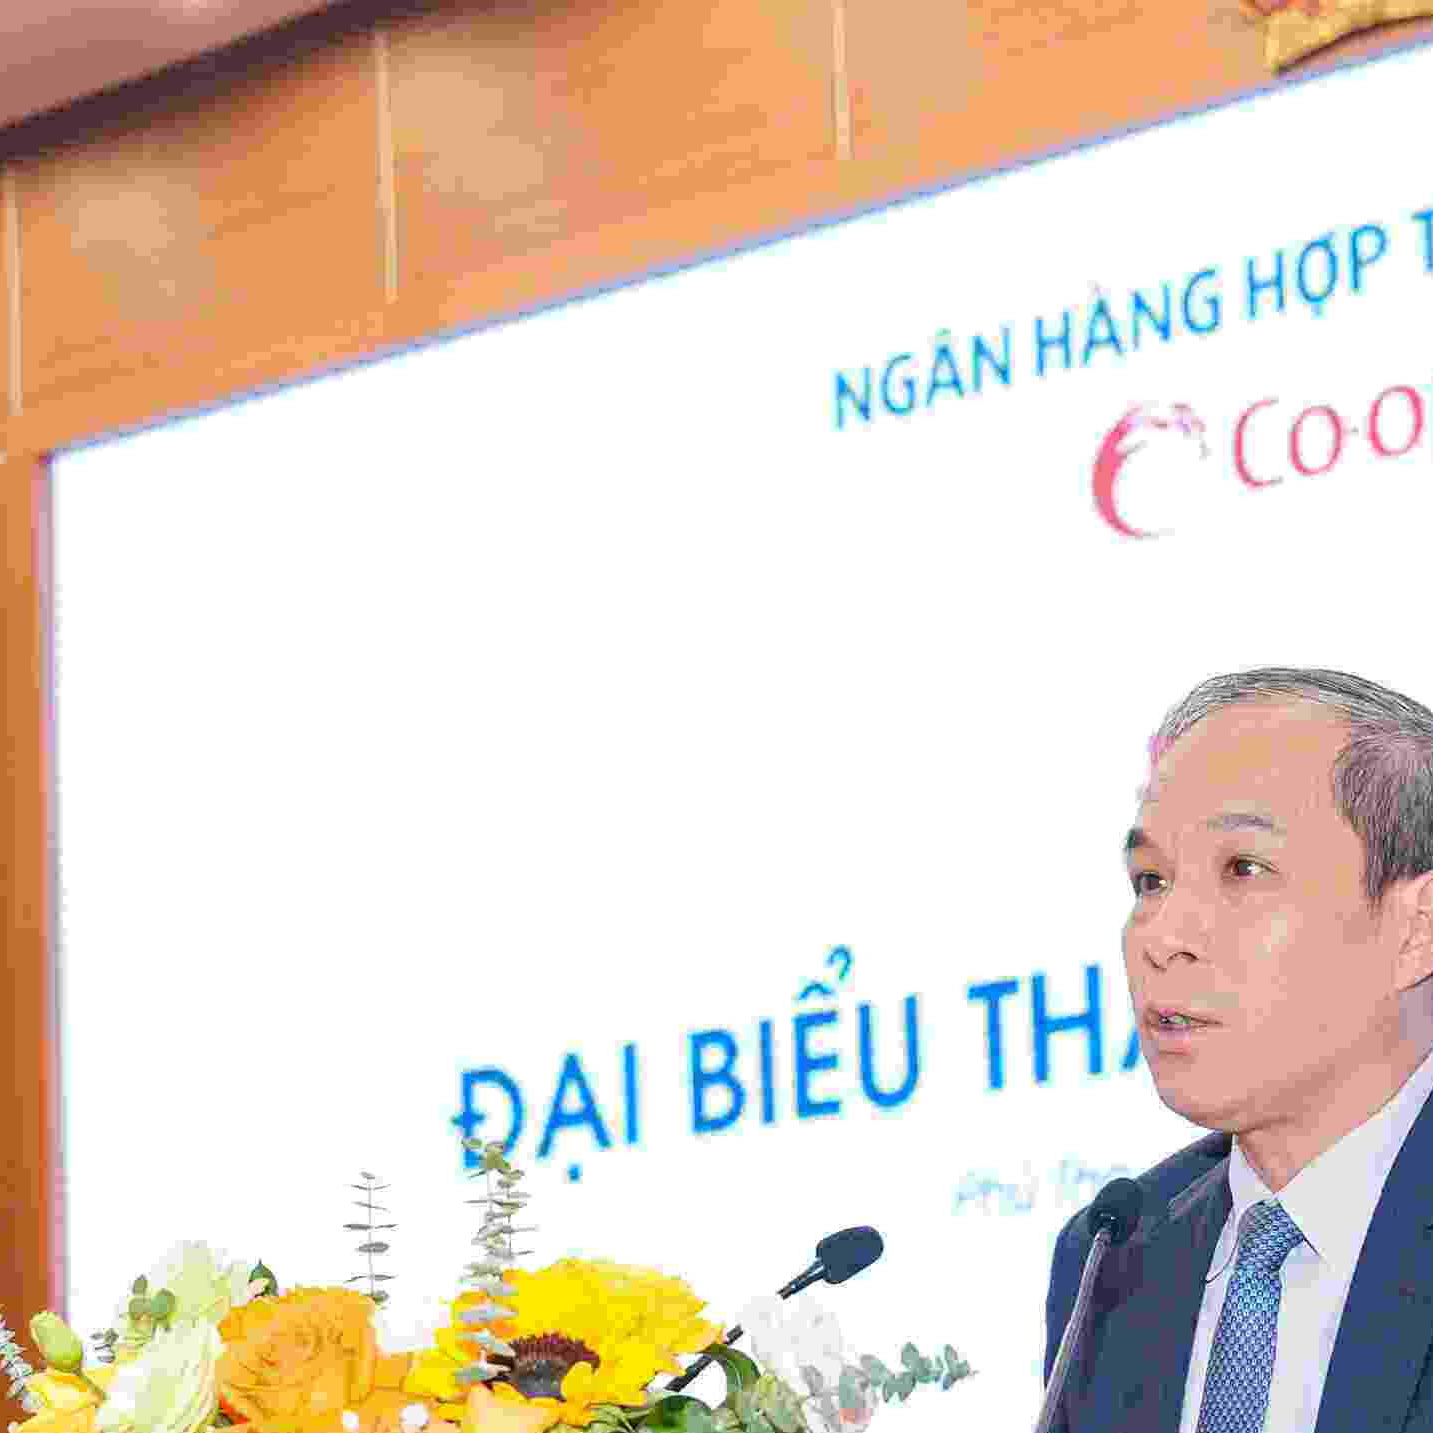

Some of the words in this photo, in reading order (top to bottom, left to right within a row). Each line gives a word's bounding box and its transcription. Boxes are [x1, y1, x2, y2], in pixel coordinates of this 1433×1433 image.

[833, 329, 1012, 431] NGÂN
[1033, 268, 1223, 377] HÀNG
[1240, 221, 1391, 320] HỢP
[449, 1039, 642, 1185] ĐẠI
[684, 943, 925, 1137] BIỂU
